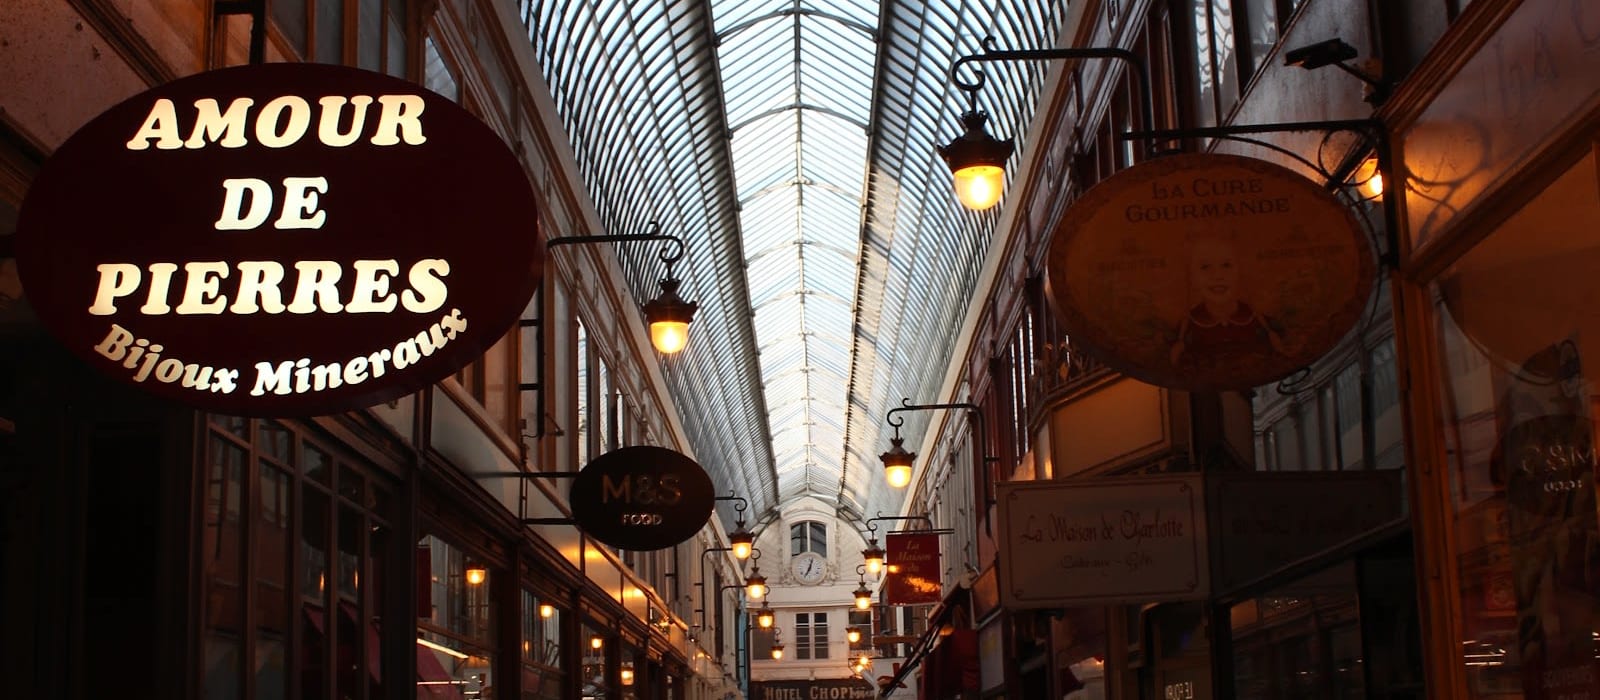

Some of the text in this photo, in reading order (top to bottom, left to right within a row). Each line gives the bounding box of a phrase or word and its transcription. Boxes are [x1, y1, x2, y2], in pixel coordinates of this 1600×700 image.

[126, 94, 427, 151] AMOUR
[214, 175, 328, 231] DE
[1151, 176, 1264, 201] LA CURE
[1124, 196, 1291, 223] GOURMANDE
[88, 257, 451, 316] PIERRES
[94, 307, 469, 397] Bijoux Mineraux
[601, 473, 683, 506] M&S
[622, 513, 663, 527] FOOD
[1019, 508, 1184, 546] La Maison de Charlotte
